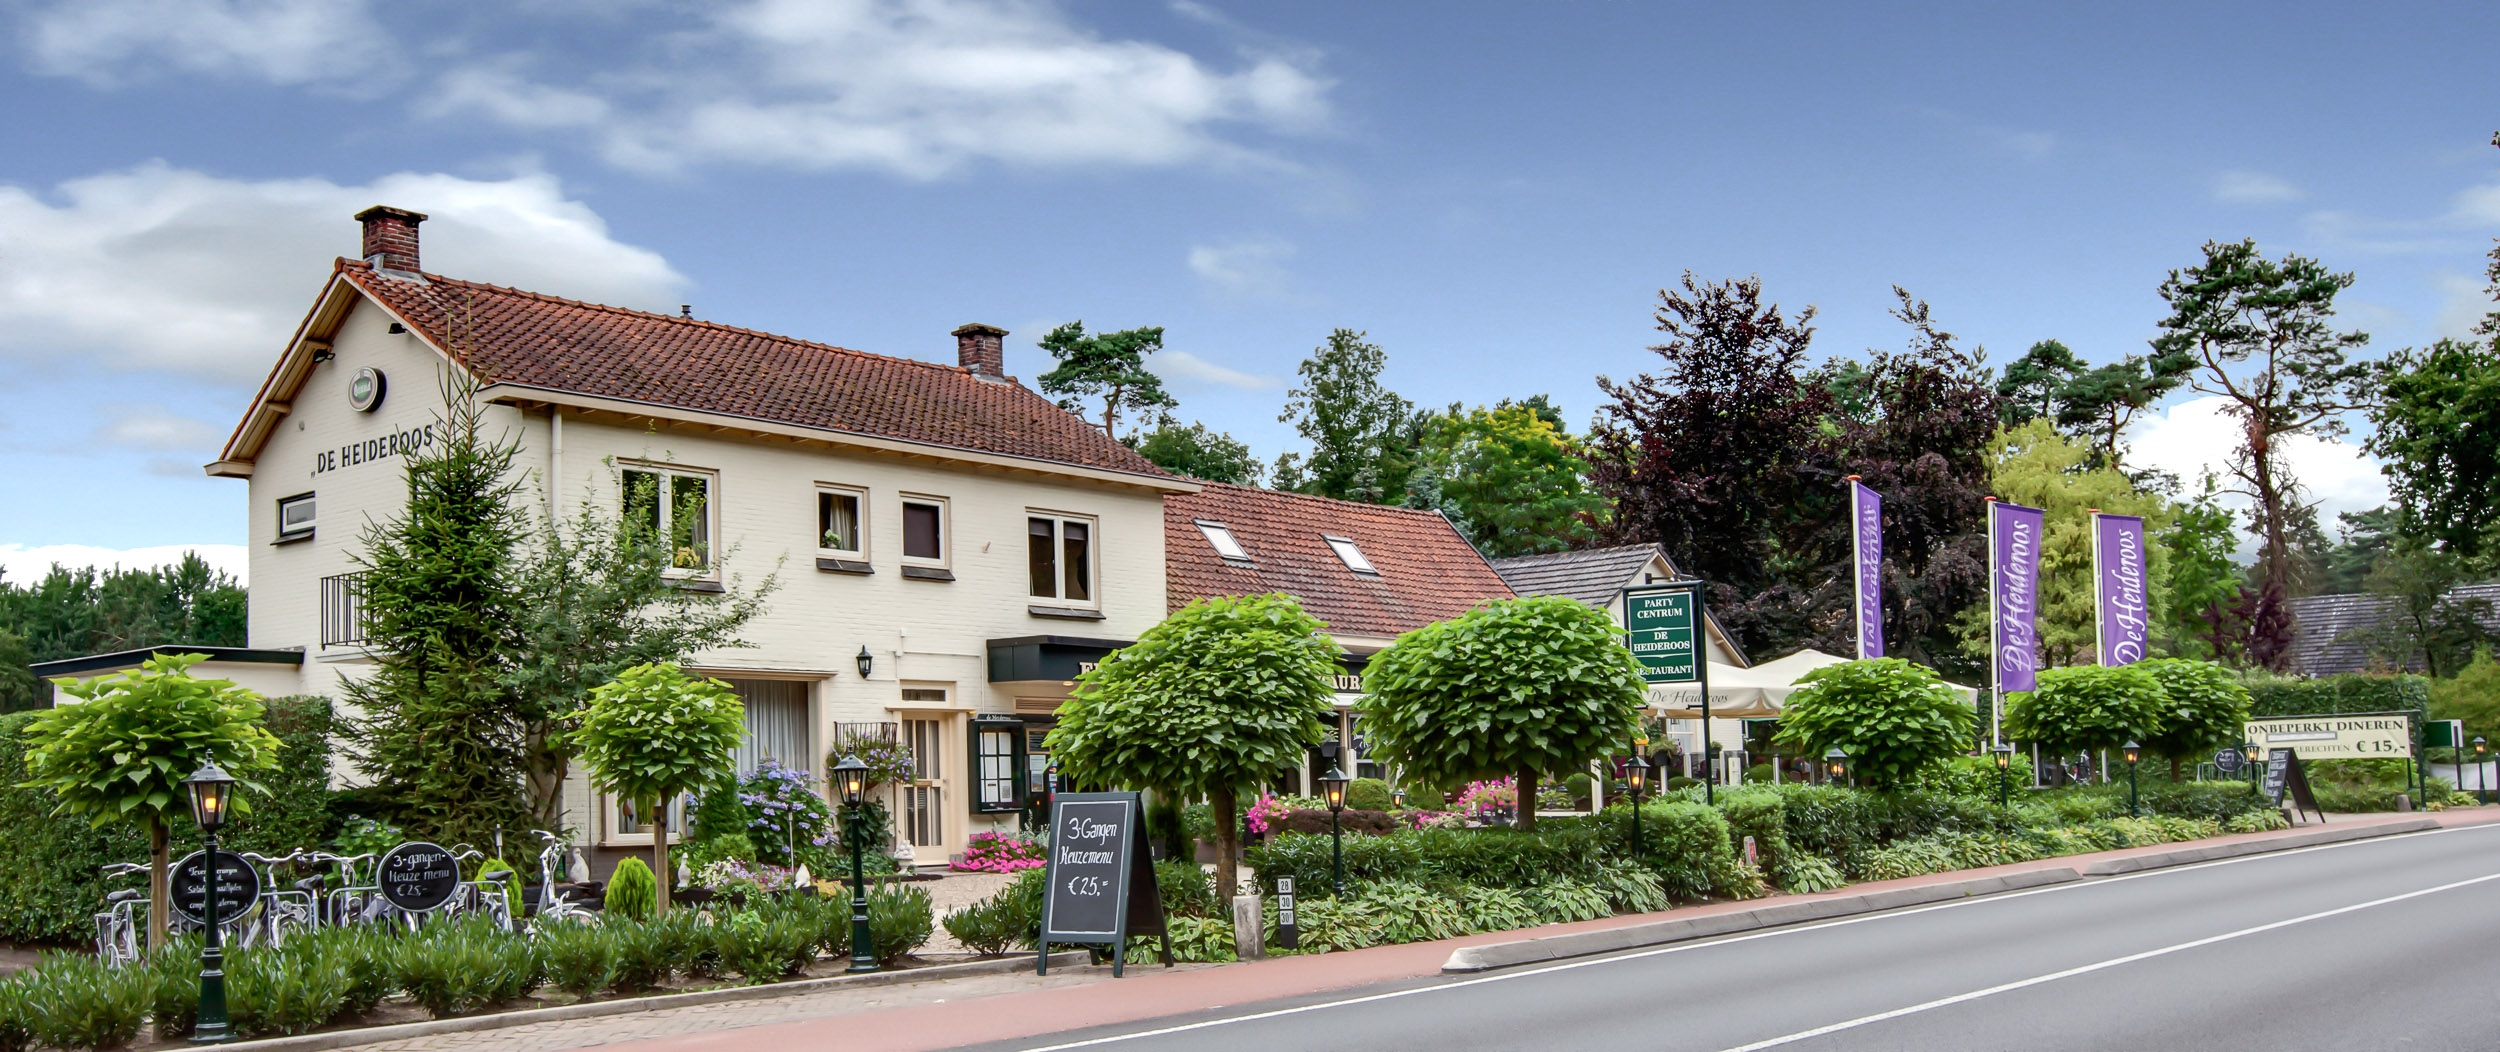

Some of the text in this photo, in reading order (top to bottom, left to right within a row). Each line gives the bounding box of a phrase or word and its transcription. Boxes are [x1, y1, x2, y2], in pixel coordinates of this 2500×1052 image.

[1644, 598, 1674, 608] PARTY
[1637, 608, 1683, 619] CENTRUM
[1654, 631, 1668, 640] DE
[1633, 641, 1691, 652] HEIDEROOS
[2248, 720, 2404, 735] ONBEPERKT DINEREN
[1059, 846, 1113, 865] Keuzemenu
[1280, 880, 1289, 891] 28
[1281, 897, 1290, 908] 30
